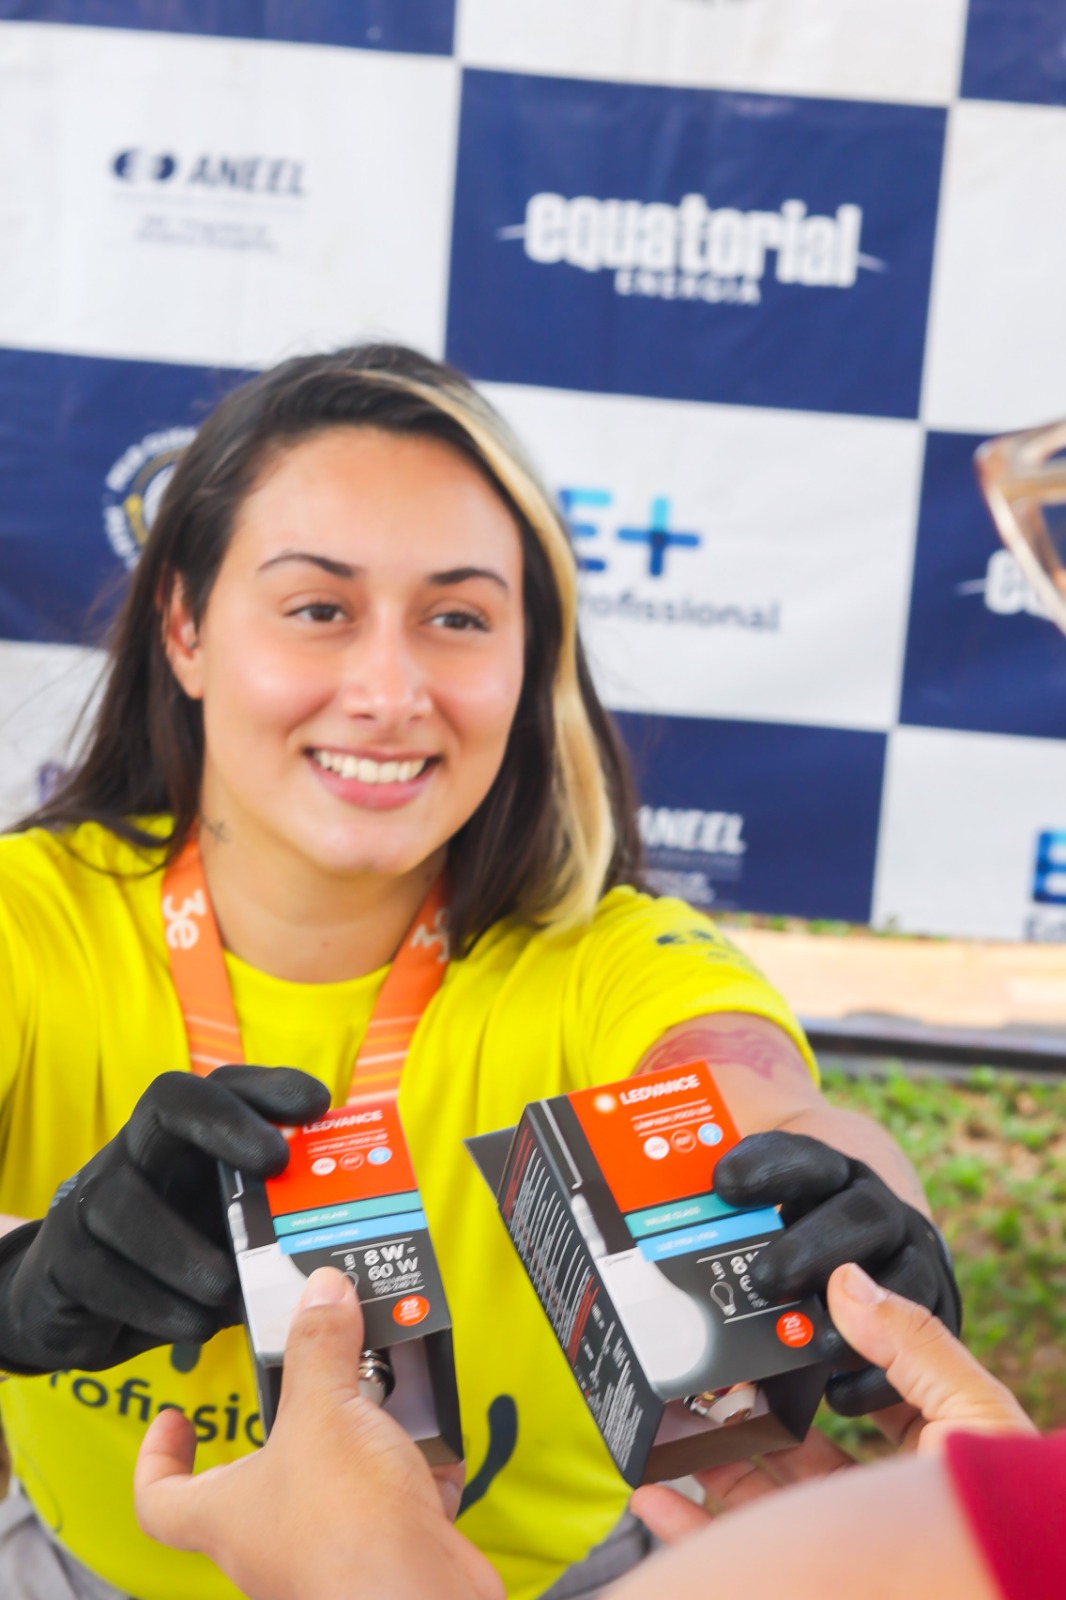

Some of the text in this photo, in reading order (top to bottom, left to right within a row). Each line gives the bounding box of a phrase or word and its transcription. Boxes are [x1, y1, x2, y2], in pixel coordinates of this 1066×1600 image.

[186, 152, 306, 198] ANEEL
[524, 191, 862, 288] equatorial
[618, 1073, 701, 1106] LEDVANCE
[302, 1110, 384, 1135] LEDVANCE
